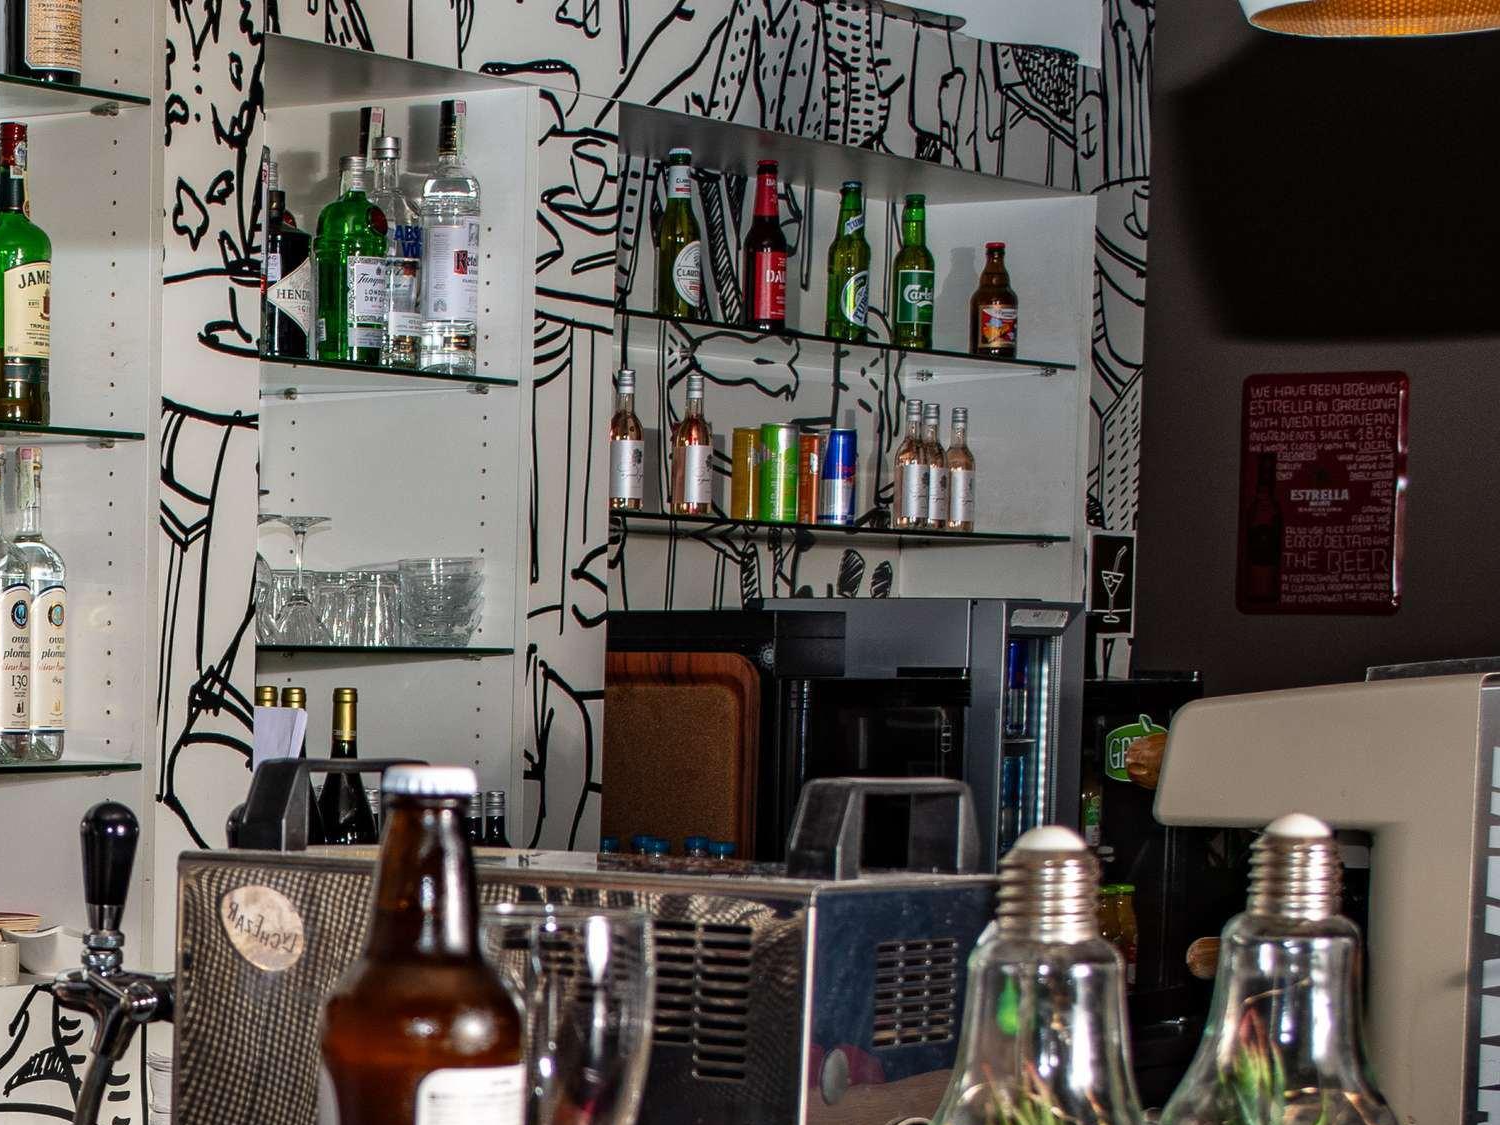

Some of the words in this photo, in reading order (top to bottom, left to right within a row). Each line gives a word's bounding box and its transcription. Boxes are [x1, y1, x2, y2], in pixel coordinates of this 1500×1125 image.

[1251, 386, 1270, 399] WE
[1274, 385, 1307, 397] HAVE
[1309, 383, 1340, 397] BEEN
[1342, 382, 1397, 397] BREWING
[1250, 400, 1313, 416] ESTRELLA
[1332, 397, 1397, 413] BARCELONA
[1281, 413, 1396, 429] MEDITERRANEAN
[1250, 430, 1316, 442] INGREDIENTS
[1320, 430, 1349, 441] SINCE
[1290, 488, 1349, 501] ESTRELLA
[1324, 534, 1362, 548] DELTA
[1283, 551, 1319, 569] THE
[1327, 548, 1390, 574] BEER
